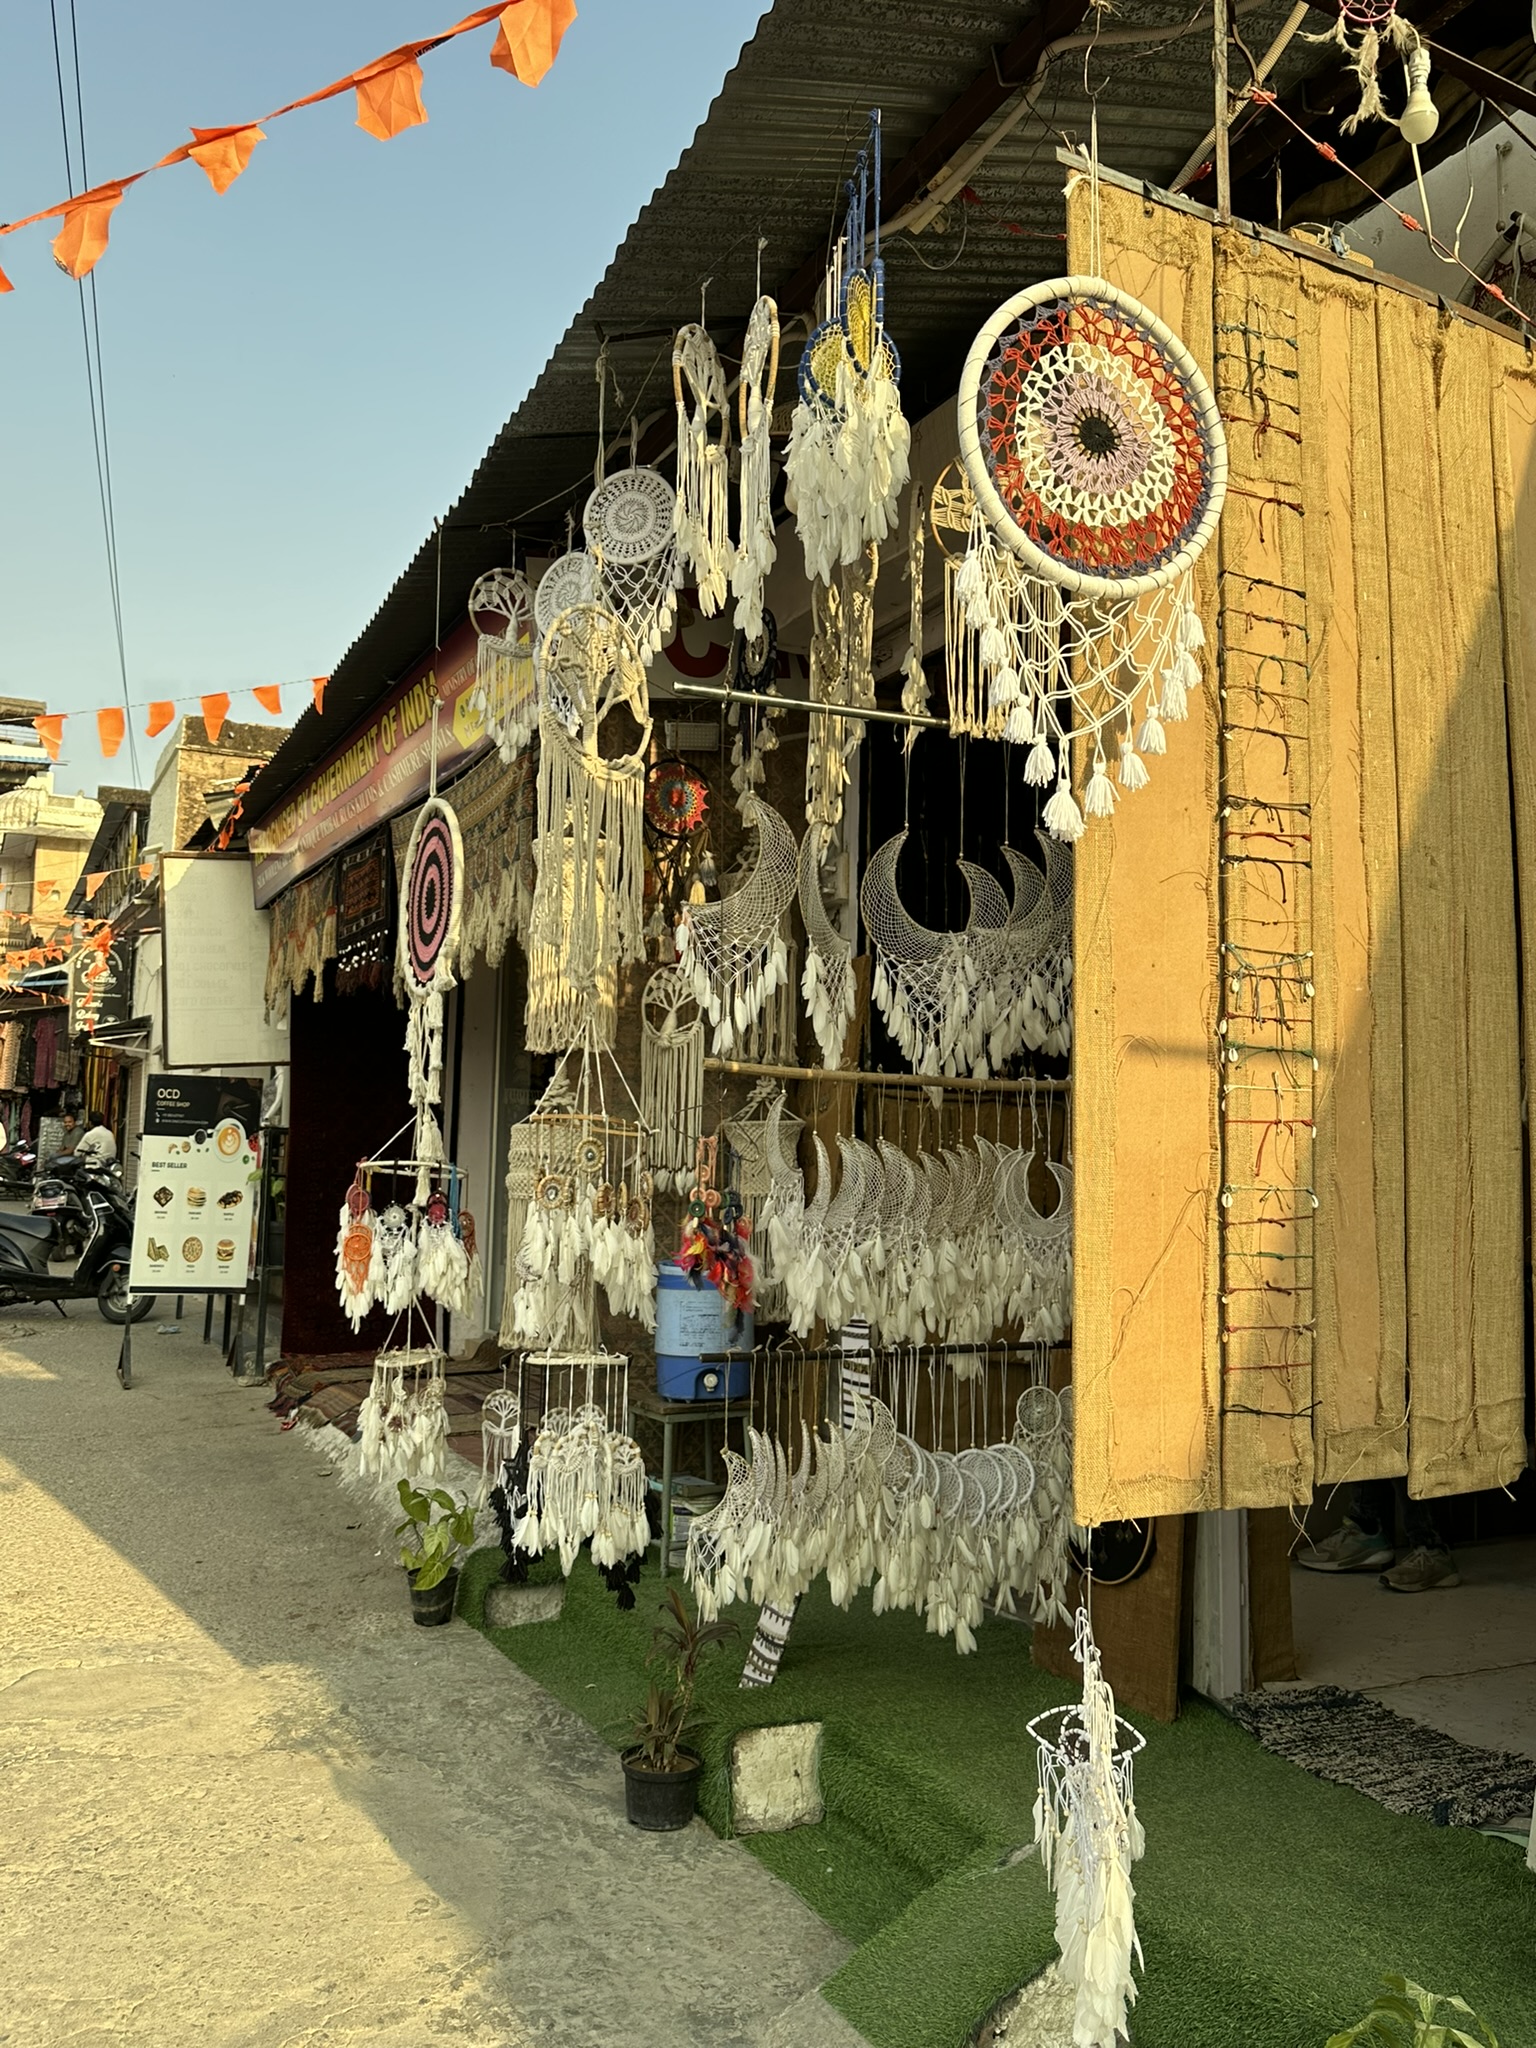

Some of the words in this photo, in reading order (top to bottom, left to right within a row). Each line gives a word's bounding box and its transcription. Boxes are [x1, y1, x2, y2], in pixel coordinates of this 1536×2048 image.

[298, 788, 309, 827] BY
[311, 724, 380, 815] GOVERNMENT
[381, 706, 398, 754] OF
[400, 670, 440, 739] INDIA
[383, 747, 422, 792] CASHMERE
[421, 723, 455, 760] SHWLS
[157, 1088, 181, 1099] OCD
